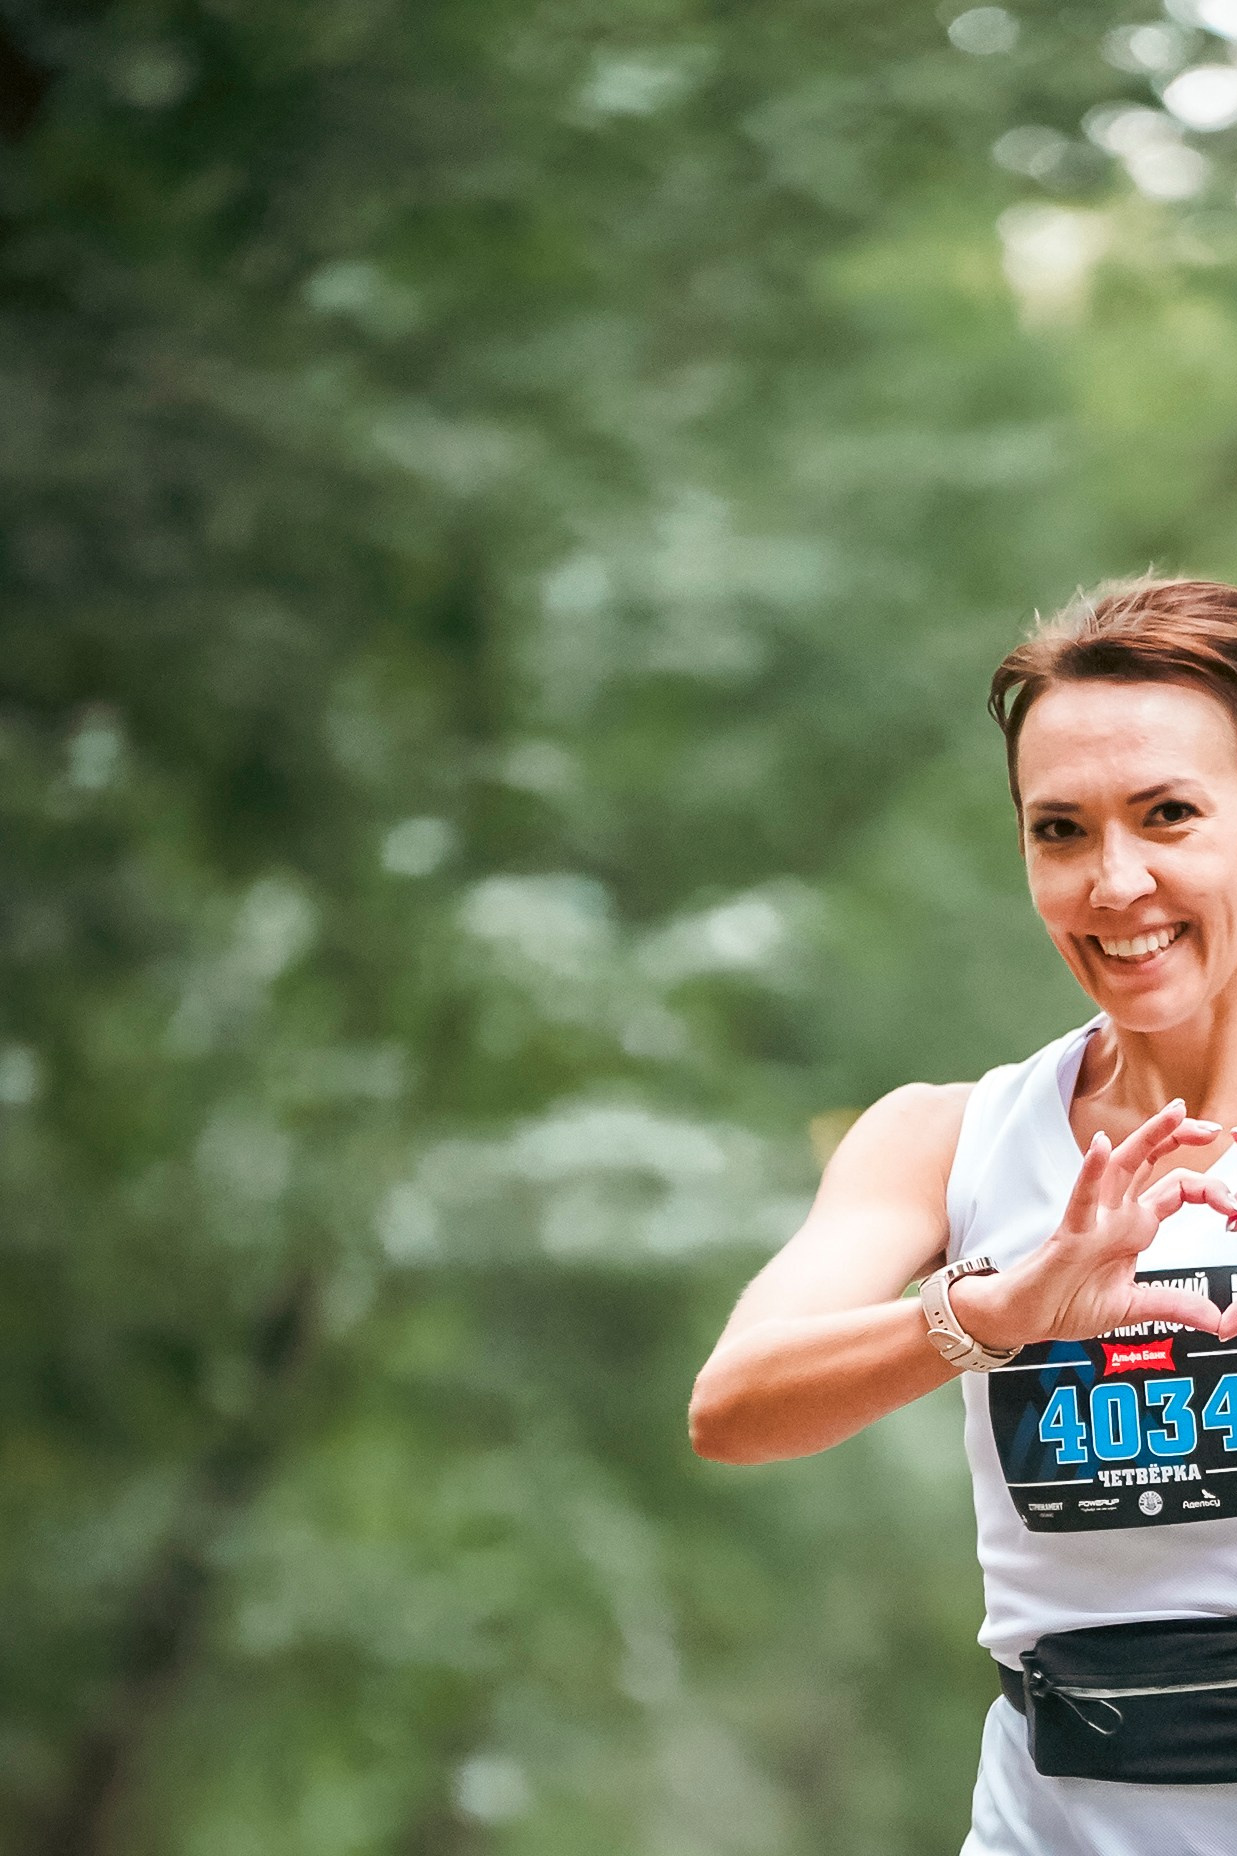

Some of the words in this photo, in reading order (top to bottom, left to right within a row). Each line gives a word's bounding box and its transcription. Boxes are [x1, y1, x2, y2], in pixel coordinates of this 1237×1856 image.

[1112, 1351, 1142, 1364] Альфа
[1143, 1350, 1166, 1361] Банк
[1097, 1463, 1202, 1487] ЧЕТВЁРКА
